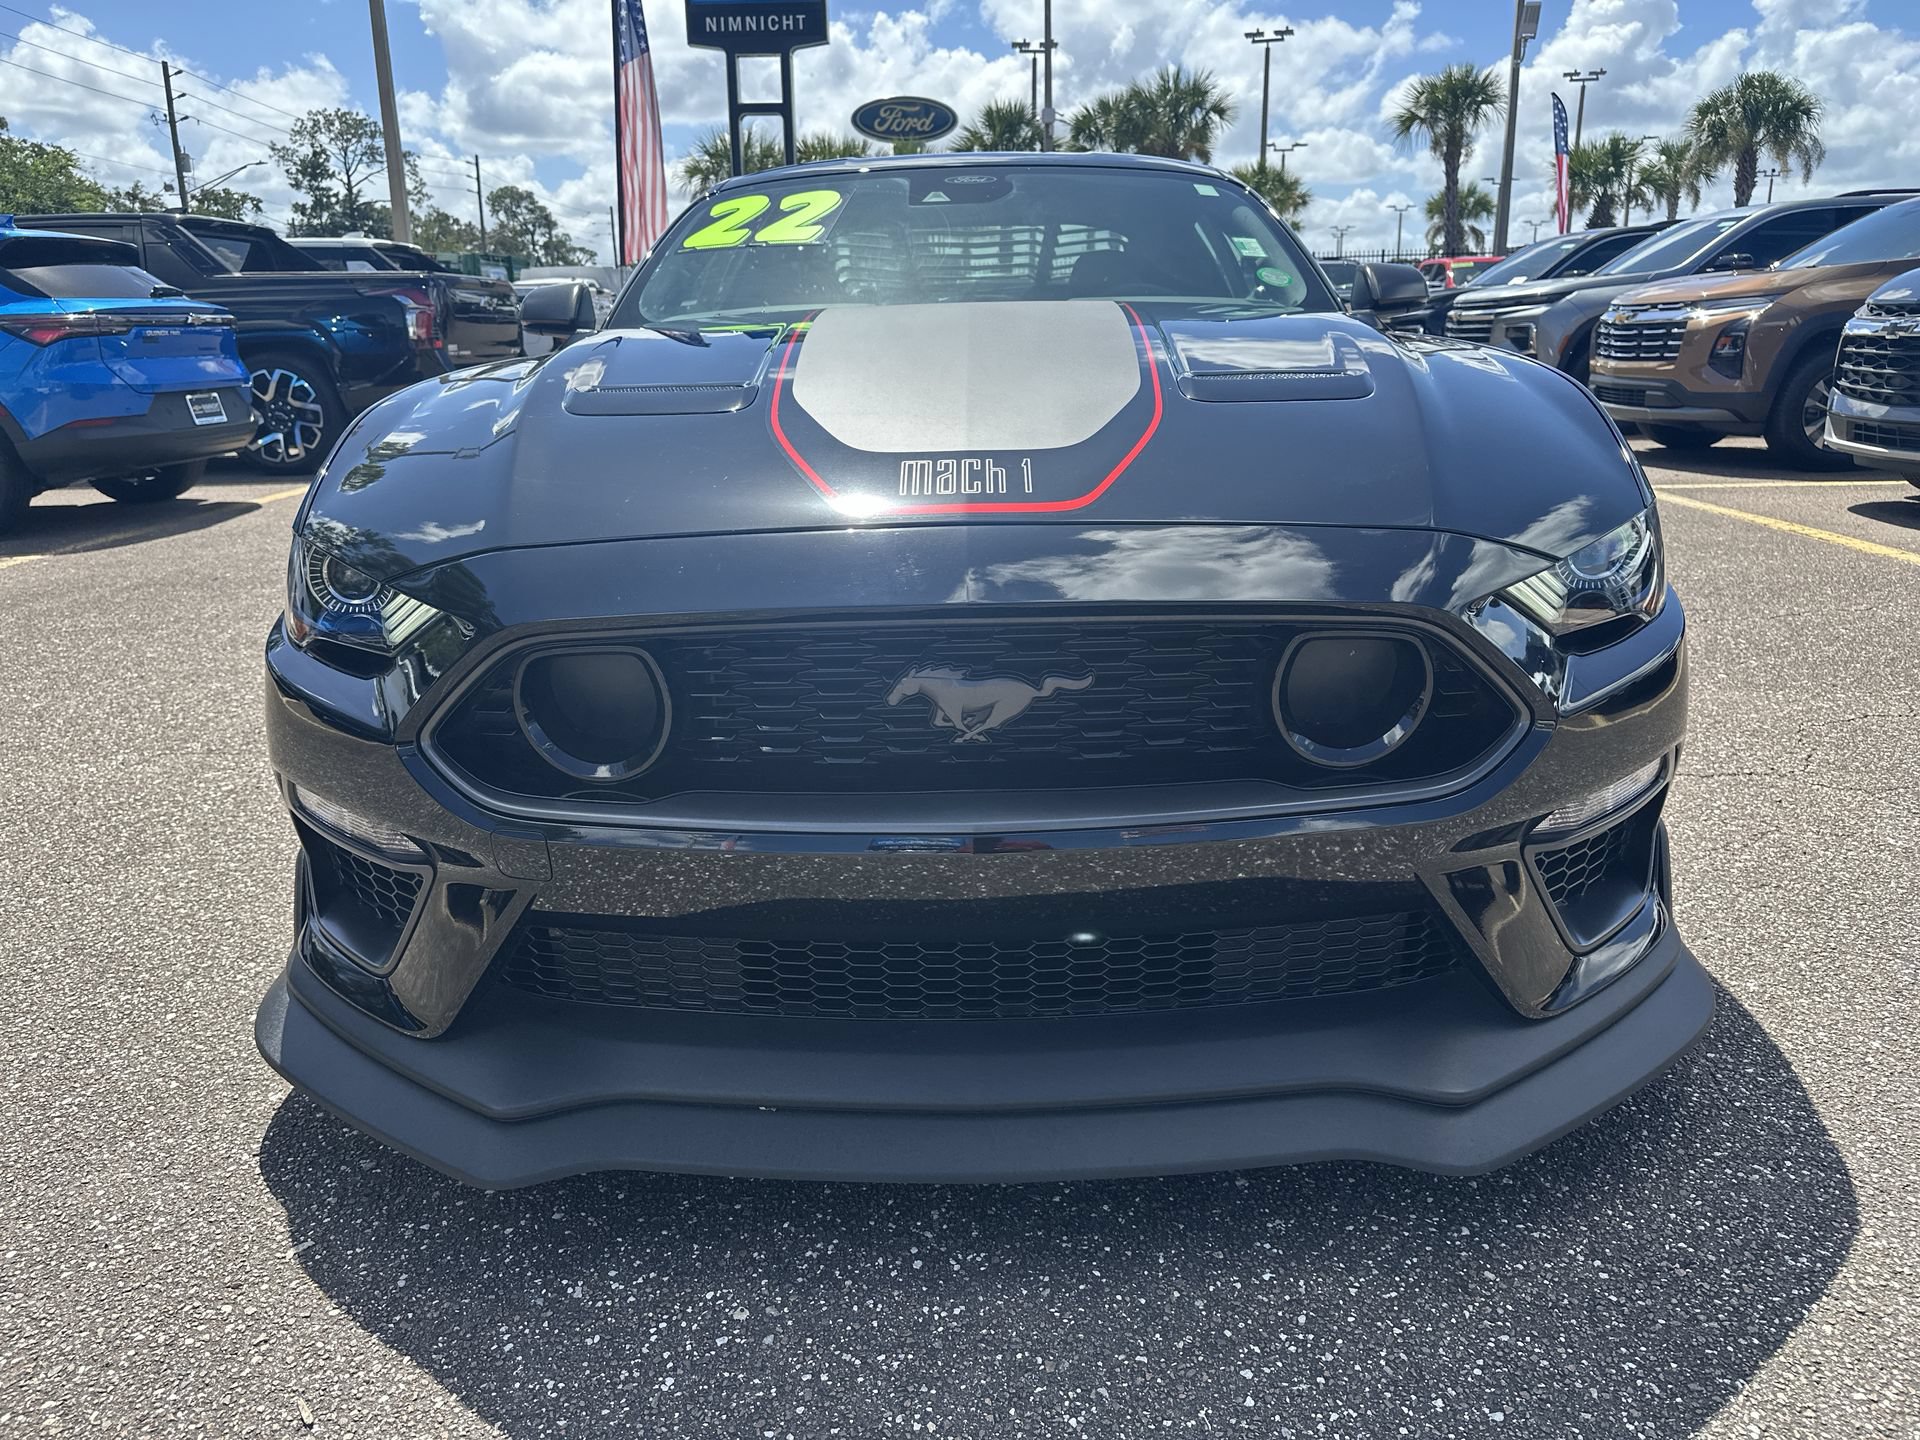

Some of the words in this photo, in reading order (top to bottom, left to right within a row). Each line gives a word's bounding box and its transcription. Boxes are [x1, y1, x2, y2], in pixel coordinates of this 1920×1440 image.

[705, 14, 806, 32] NIMNICHT
[873, 104, 936, 132] Ford
[683, 190, 842, 249] 22
[1021, 458, 1032, 493] 1
